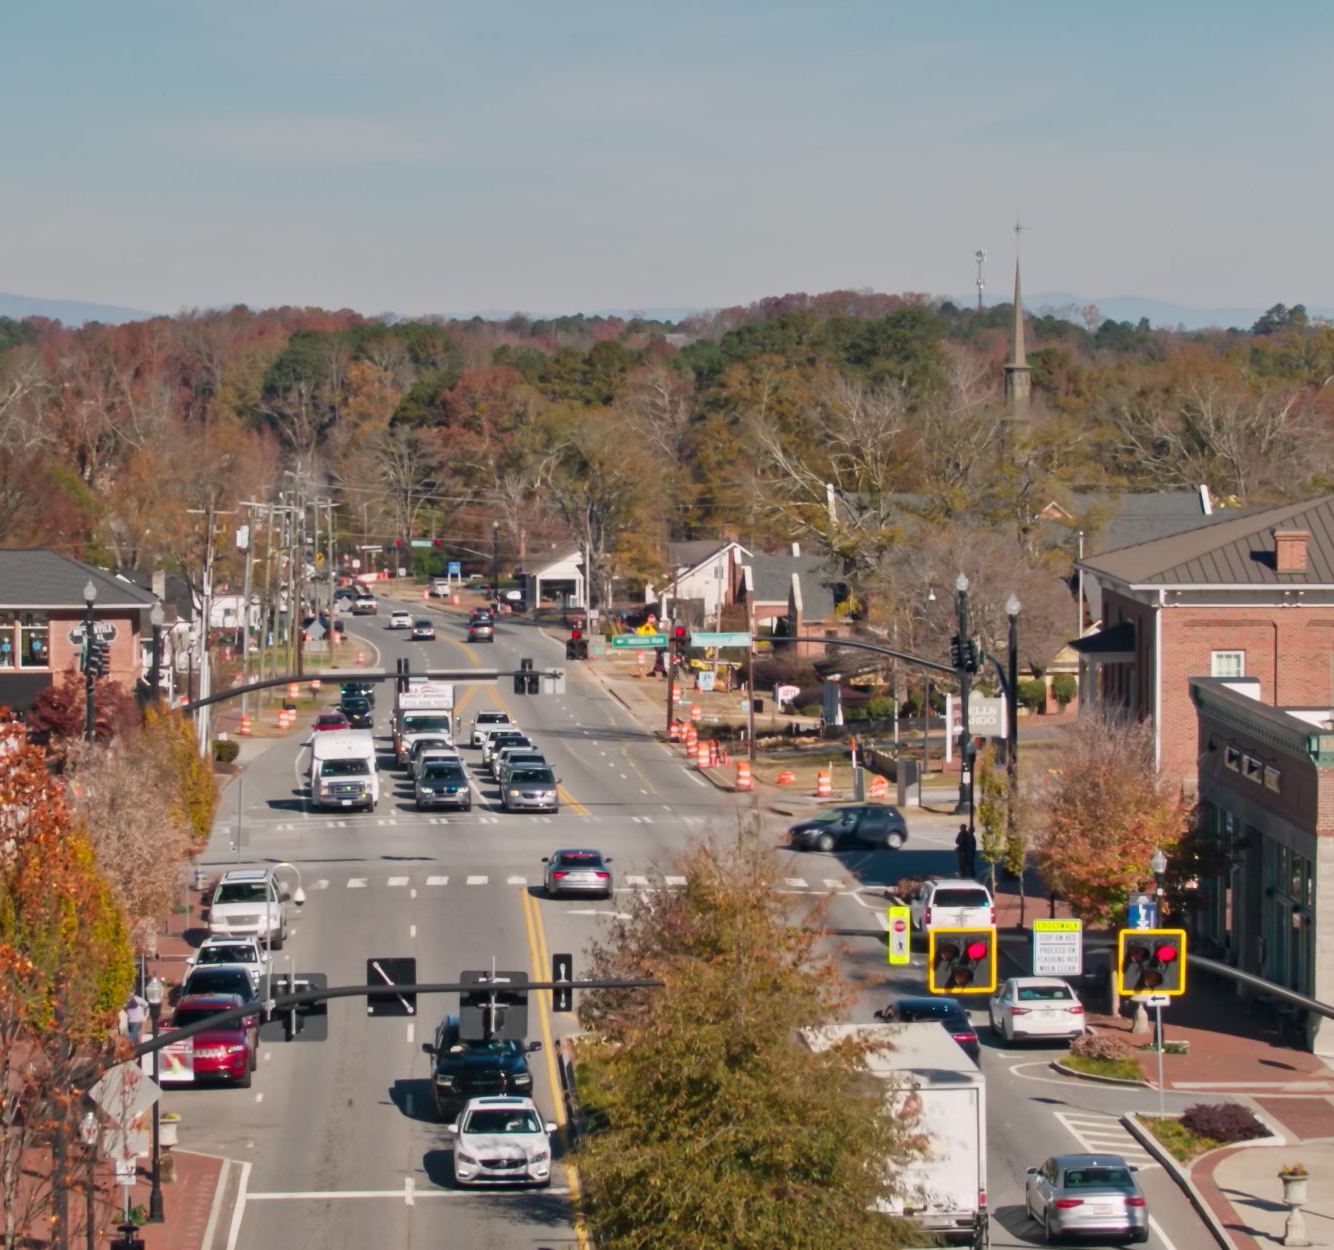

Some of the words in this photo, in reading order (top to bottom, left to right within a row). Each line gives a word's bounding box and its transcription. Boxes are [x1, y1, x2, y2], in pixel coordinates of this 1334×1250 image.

[1037, 921, 1077, 929] CROSSWALK
[1039, 946, 1066, 954] PROCEED
[1068, 946, 1076, 954] ON
[1037, 955, 1065, 963] FLASHING
[1067, 955, 1078, 963] RED
